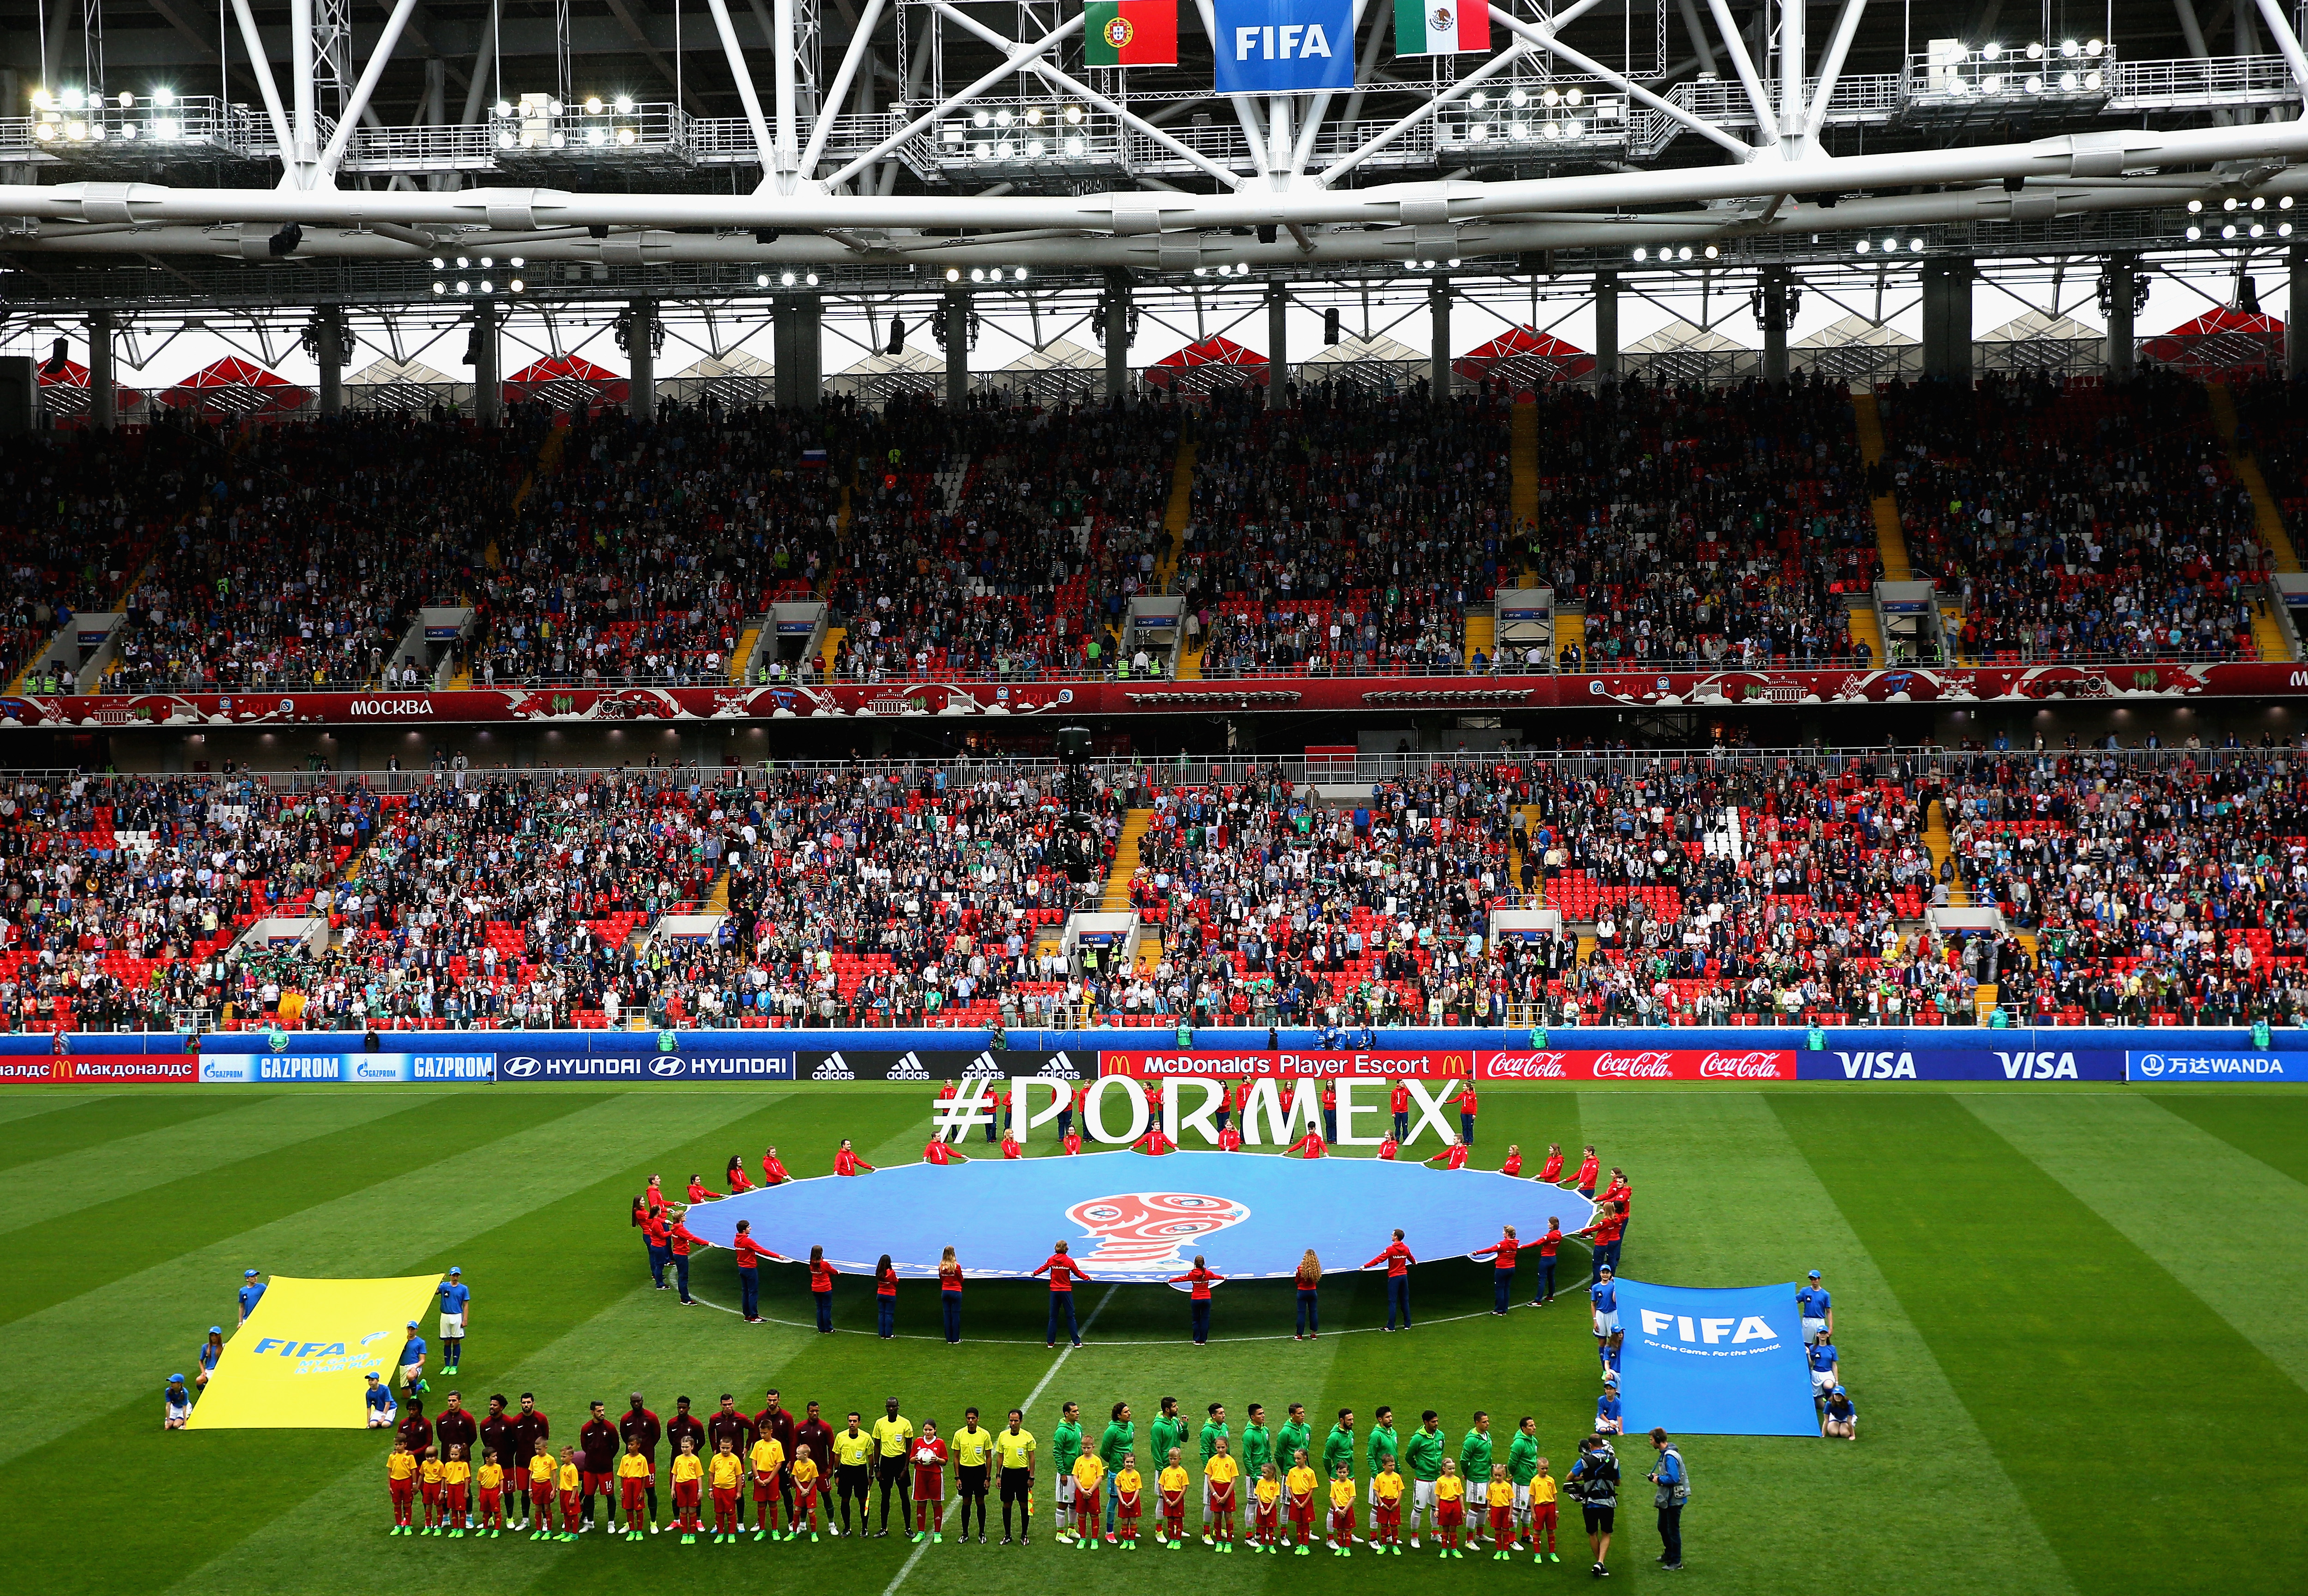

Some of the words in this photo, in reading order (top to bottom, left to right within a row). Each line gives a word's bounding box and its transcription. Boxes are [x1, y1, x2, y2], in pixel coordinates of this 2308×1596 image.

[1236, 24, 1331, 60] FIFA
[350, 700, 433, 715] МОСКВА
[76, 1064, 192, 1077] Макдоналдс
[261, 1058, 338, 1078] GAZPROM
[414, 1057, 492, 1077] GAZPROM
[547, 1059, 640, 1074] HYUNDAI
[691, 1058, 786, 1073] HYUNDAI
[1143, 1056, 1271, 1074] McDonald's
[1280, 1055, 1348, 1077] Player
[1355, 1055, 1430, 1074] Escort
[1487, 1052, 1566, 1077] Coca-Cola
[1593, 1052, 1673, 1077] Coca-Cola
[1700, 1052, 1780, 1077] Coca-Cola
[1833, 1052, 1917, 1079] VISA
[1993, 1052, 2078, 1079] VISA
[812, 1069, 855, 1080] adidas
[887, 1069, 930, 1080] adidas
[961, 1069, 1005, 1080] adidas
[933, 1074, 1460, 1146] #PORMEX
[1640, 1308, 1778, 1344] FIFA
[254, 1338, 344, 1357] FIFA
[1644, 1339, 1660, 1347] For
[1661, 1343, 1678, 1351] the
[1679, 1346, 1710, 1356] Game.
[1749, 1343, 1781, 1354] World.
[312, 1364, 344, 1373] FAIR
[349, 1358, 384, 1369] PLAY
[327, 1353, 370, 1365] GAME
[507, 1480, 514, 1488] 19
[605, 1480, 612, 1489] 16
